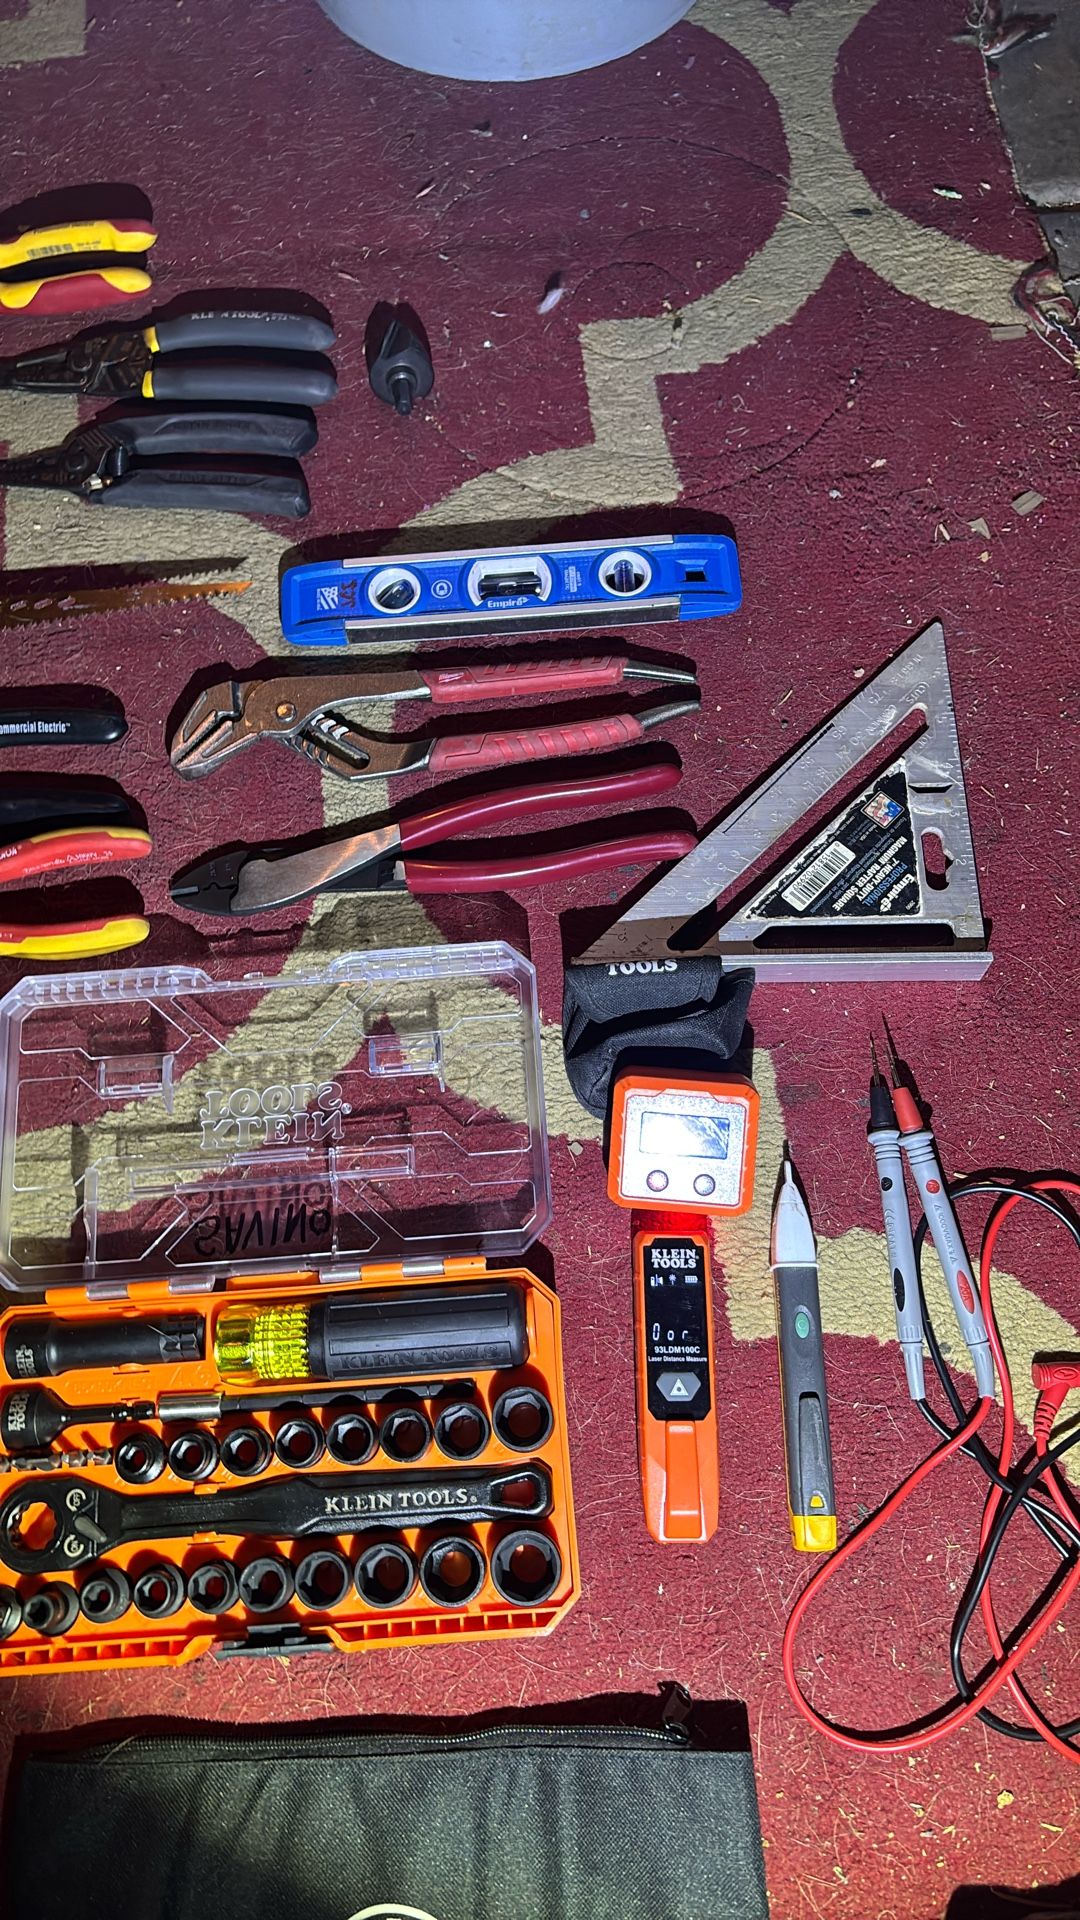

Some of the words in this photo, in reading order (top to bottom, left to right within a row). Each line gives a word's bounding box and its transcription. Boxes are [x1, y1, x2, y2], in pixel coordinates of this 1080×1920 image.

[0, 720, 36, 735] ommercial
[810, 851, 831, 872] 15812
[791, 869, 813, 891] 02990
[854, 862, 881, 888] RAFTER
[854, 863, 893, 901] HEAVY-DUTY
[861, 860, 908, 908] PROFESSIONAL
[831, 884, 858, 911] SQUARE
[879, 873, 915, 911] Empire
[606, 959, 678, 976] TOOLS
[651, 1248, 697, 1259] KLEIN
[651, 1259, 697, 1269] TOOLS
[654, 1346, 701, 1354] 93LDM100C
[324, 1493, 393, 1514] KLEIN
[398, 1488, 469, 1507] TOOLS
